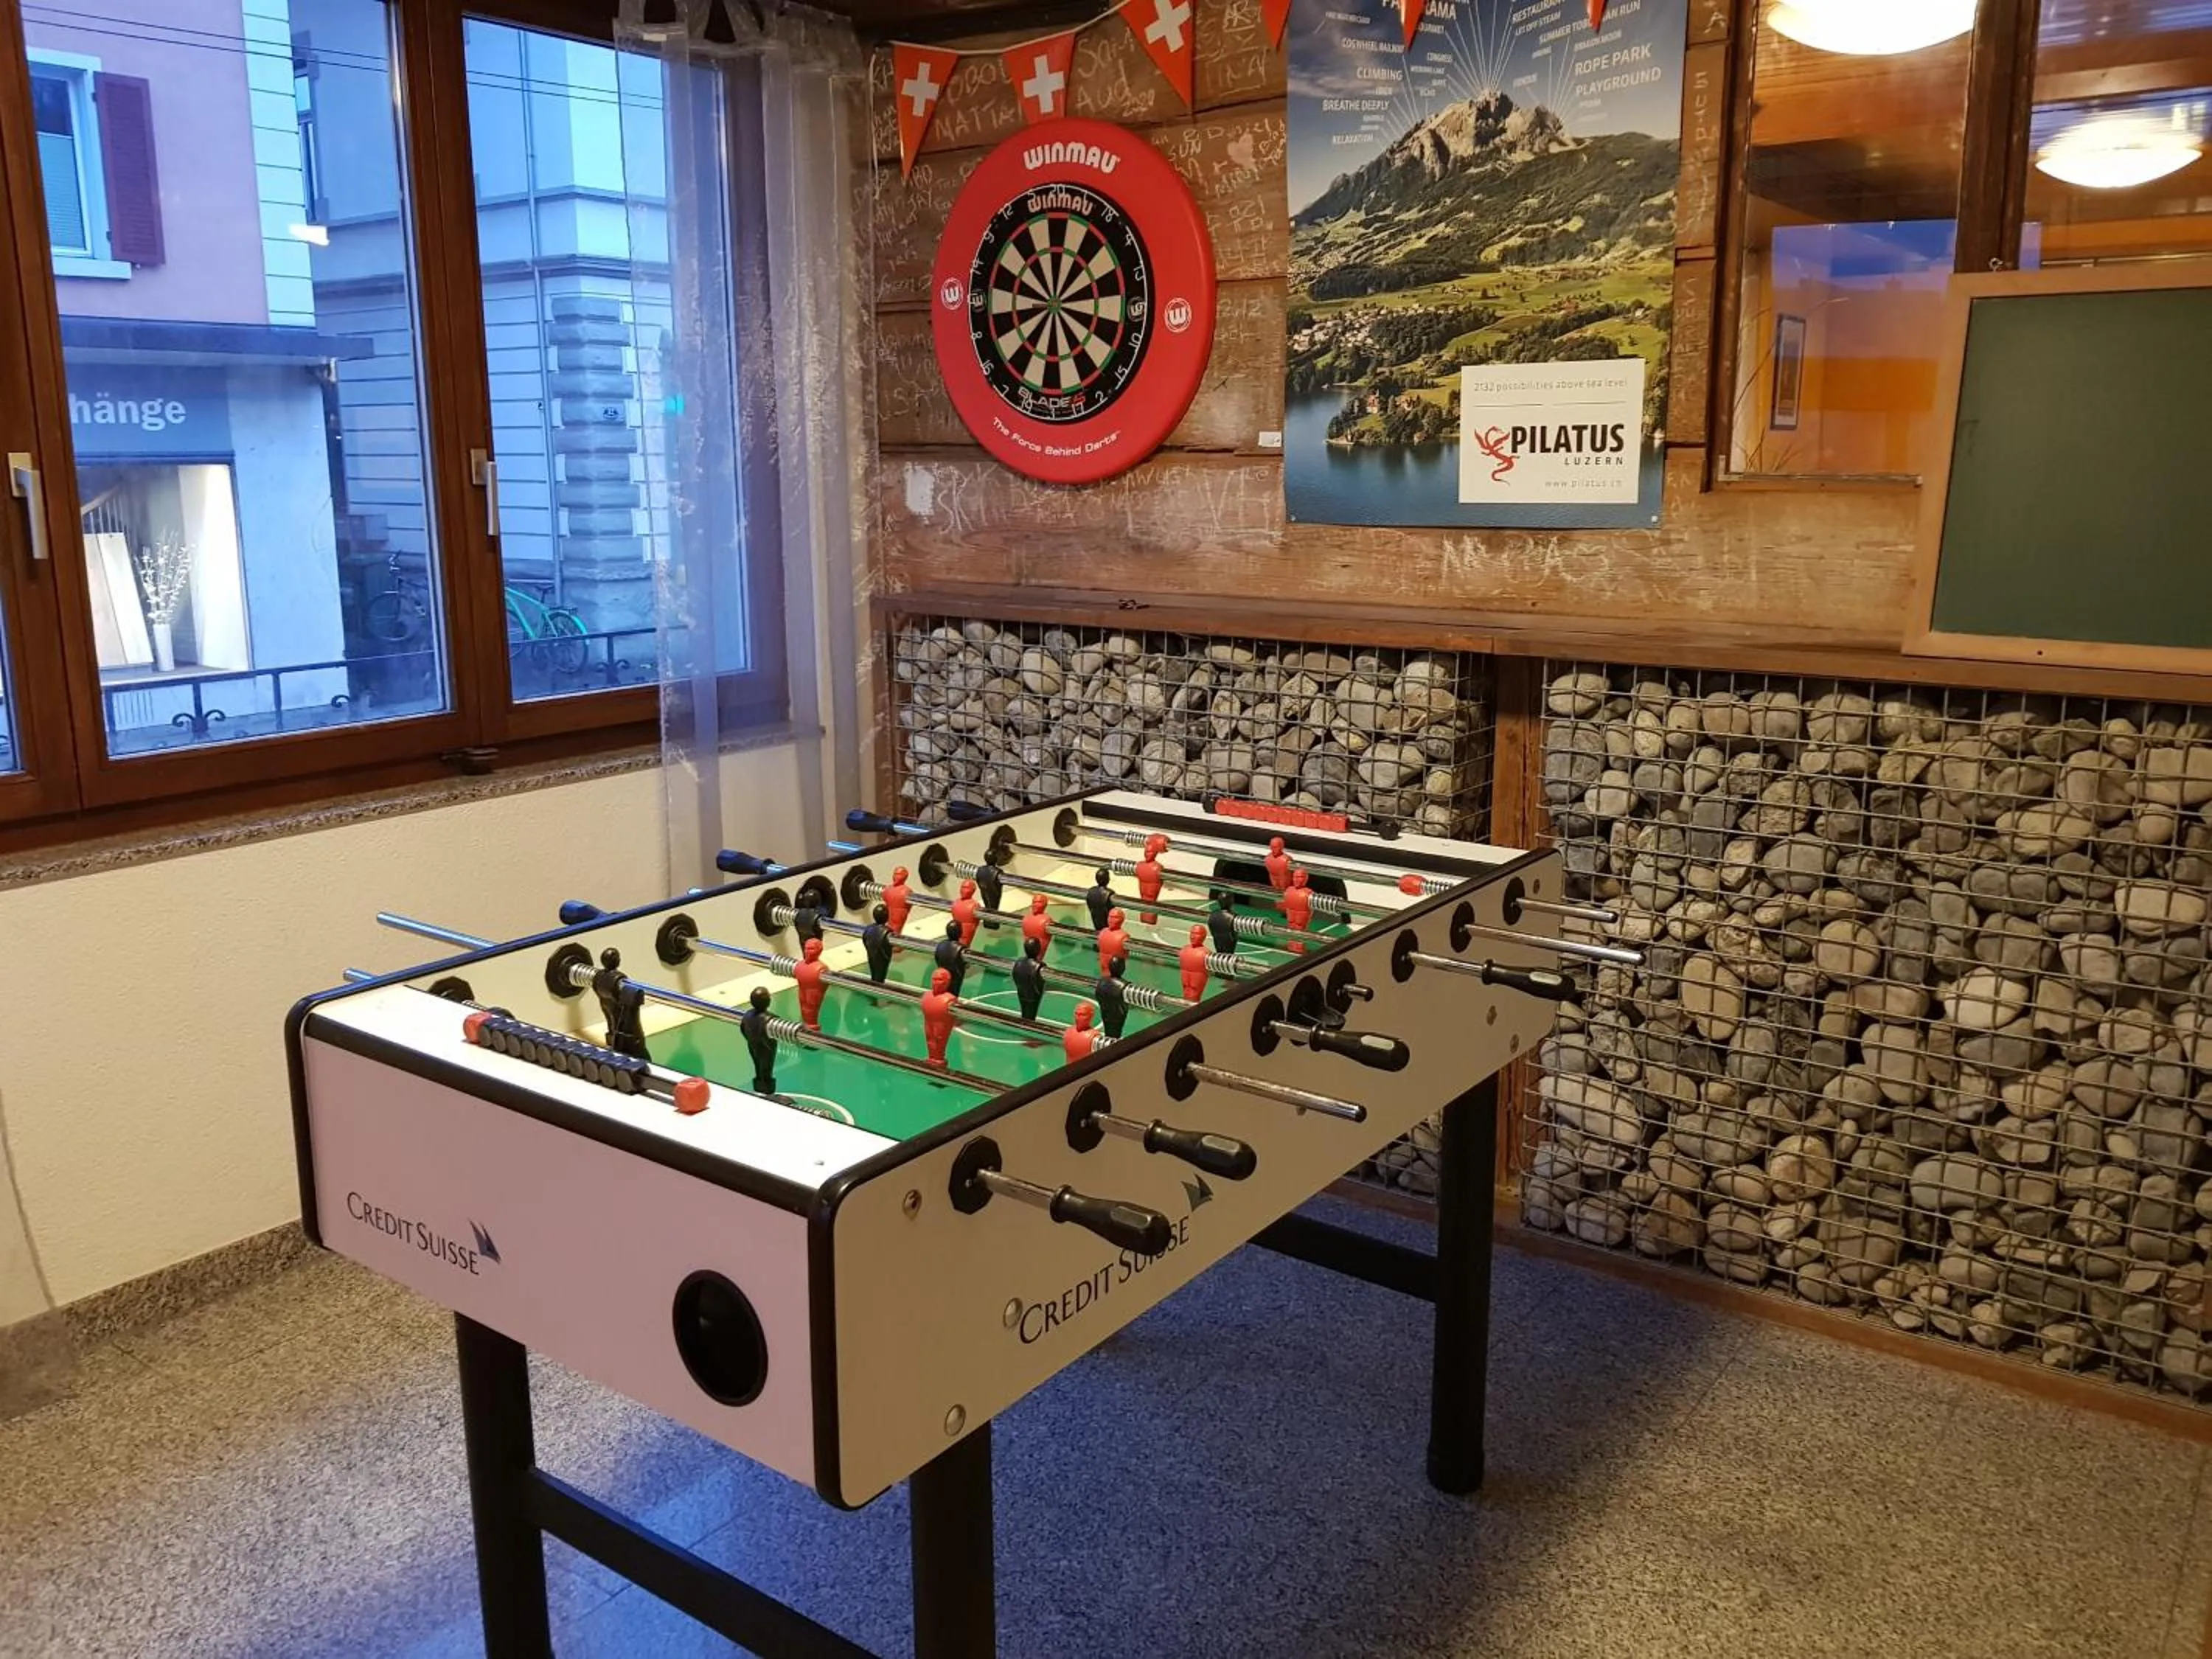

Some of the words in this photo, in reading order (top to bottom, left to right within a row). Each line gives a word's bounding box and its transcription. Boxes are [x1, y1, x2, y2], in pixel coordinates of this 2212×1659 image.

[1356, 67, 1403, 80] CLIMBING
[1574, 54, 1610, 77] ROPE
[1612, 42, 1652, 67] PARK
[1576, 66, 1661, 96] PLAYGROUND
[1322, 100, 1361, 111] BREATHE
[1361, 100, 1390, 111] DEEPLY
[1332, 133, 1374, 145] RELAXATION
[1023, 142, 1116, 173] WINMAU
[1027, 193, 1093, 216] WINMAU
[1555, 378, 1584, 389] above
[993, 417, 1009, 436] The
[1011, 433, 1042, 453] Force
[1045, 445, 1082, 457] Behind
[1085, 433, 1117, 453] Darts
[1512, 423, 1624, 453] PILATUS
[1565, 456, 1624, 466] LUZERN
[347, 1192, 413, 1243] CREDIT
[416, 1222, 480, 1276] SUISSE
[1020, 1264, 1114, 1344] CREDIT
